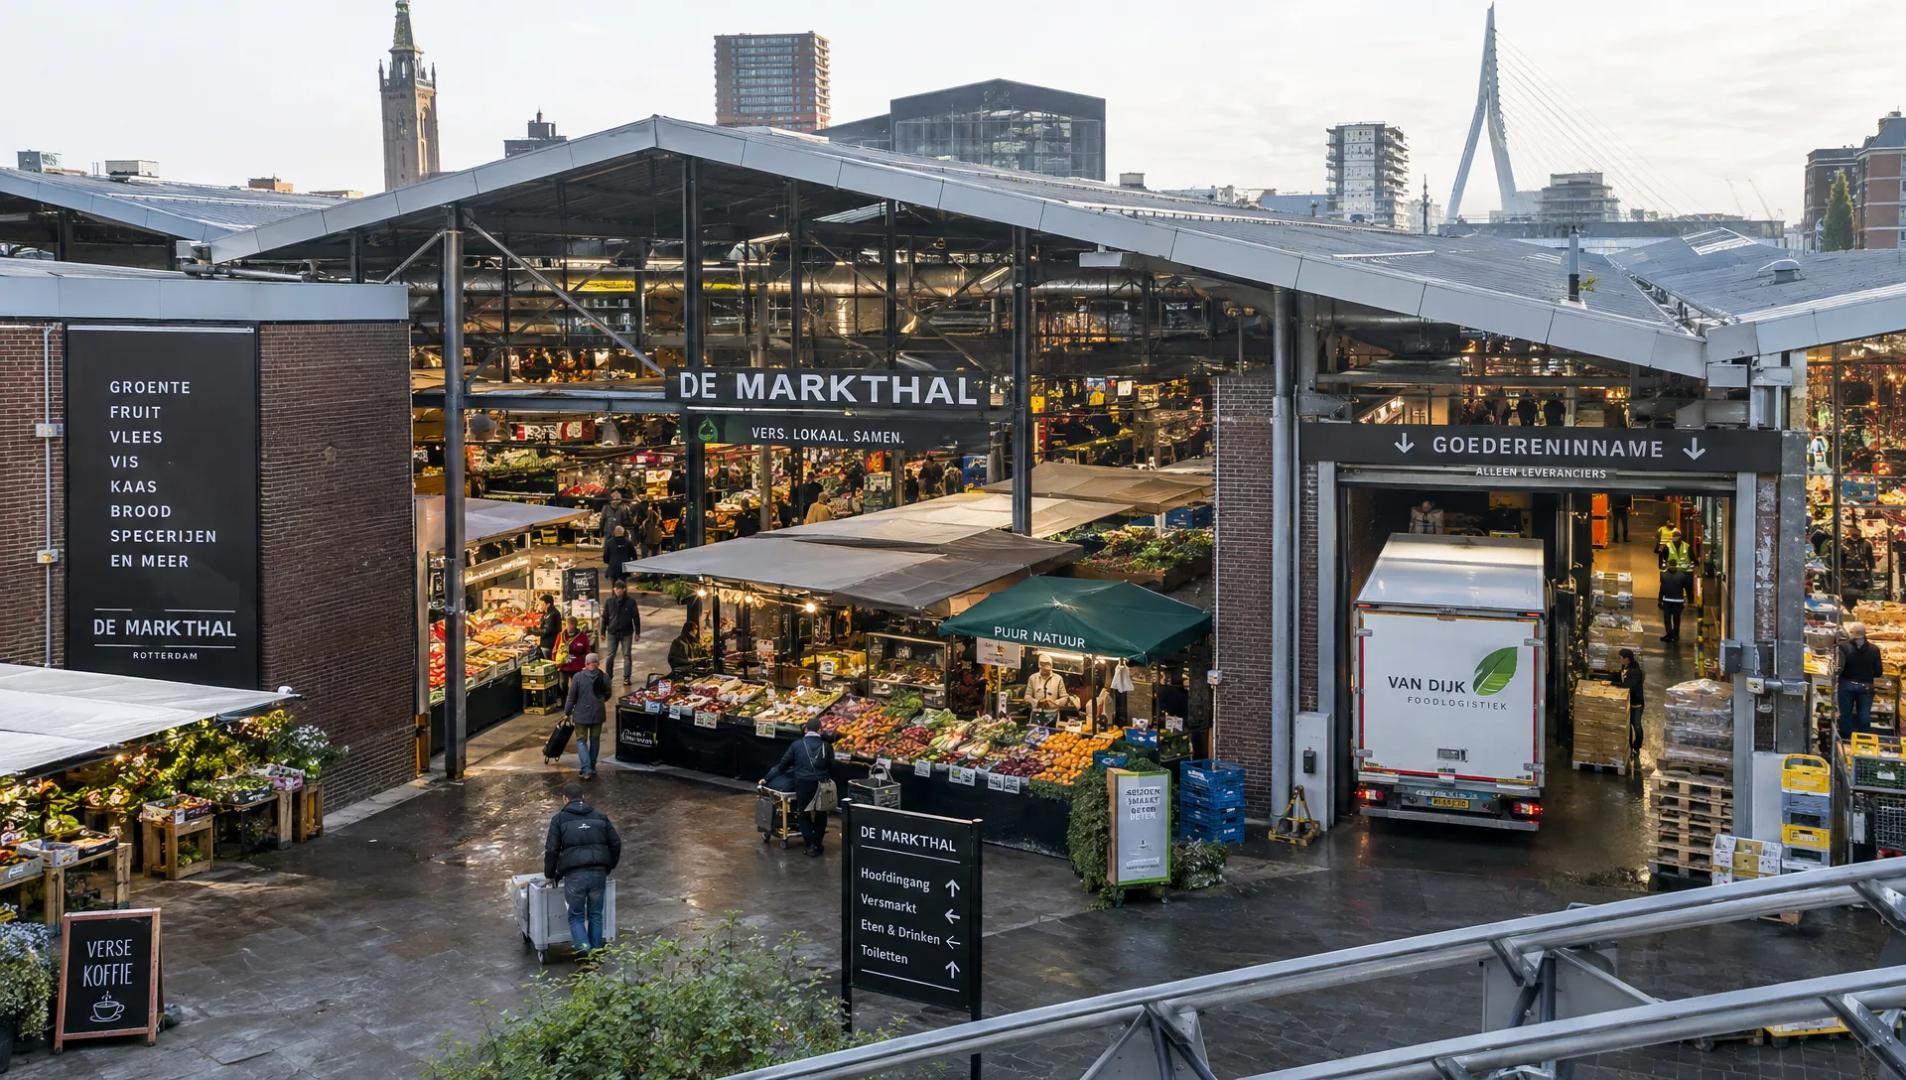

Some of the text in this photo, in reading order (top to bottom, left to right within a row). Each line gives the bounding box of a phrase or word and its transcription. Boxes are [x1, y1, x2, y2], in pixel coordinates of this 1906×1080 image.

[110, 381, 190, 393] GROENTE
[680, 372, 977, 404] DE MARKTHAL
[111, 406, 160, 418] FRUIT
[110, 431, 162, 443] VLEES
[752, 428, 904, 443] VERS. LOKAAL. SAMEN.
[1433, 437, 1662, 457] GOEDERENINNAME
[111, 456, 138, 467] VIS
[1477, 467, 1606, 478] ALLEEN LEVERANCIERS
[112, 481, 156, 492] KAAS
[112, 505, 170, 517] BROOD
[111, 530, 215, 542] SPECERIJEN
[112, 555, 188, 567] EN MEER
[95, 619, 236, 636] DE MARKTHAL
[994, 626, 1086, 648] PUUR NATUUR
[1388, 676, 1465, 693] VAN DIJK
[1408, 697, 1506, 710] FOODLOGISTIEK
[861, 826, 956, 854] DE MARKTHAL
[861, 868, 929, 892] Hoofdingang
[861, 894, 916, 913] Versmarkt
[861, 919, 939, 944] Eten & Drinken
[88, 939, 132, 957] VERSE
[861, 945, 907, 964] Toiletten
[84, 963, 132, 986] KOFFIE
